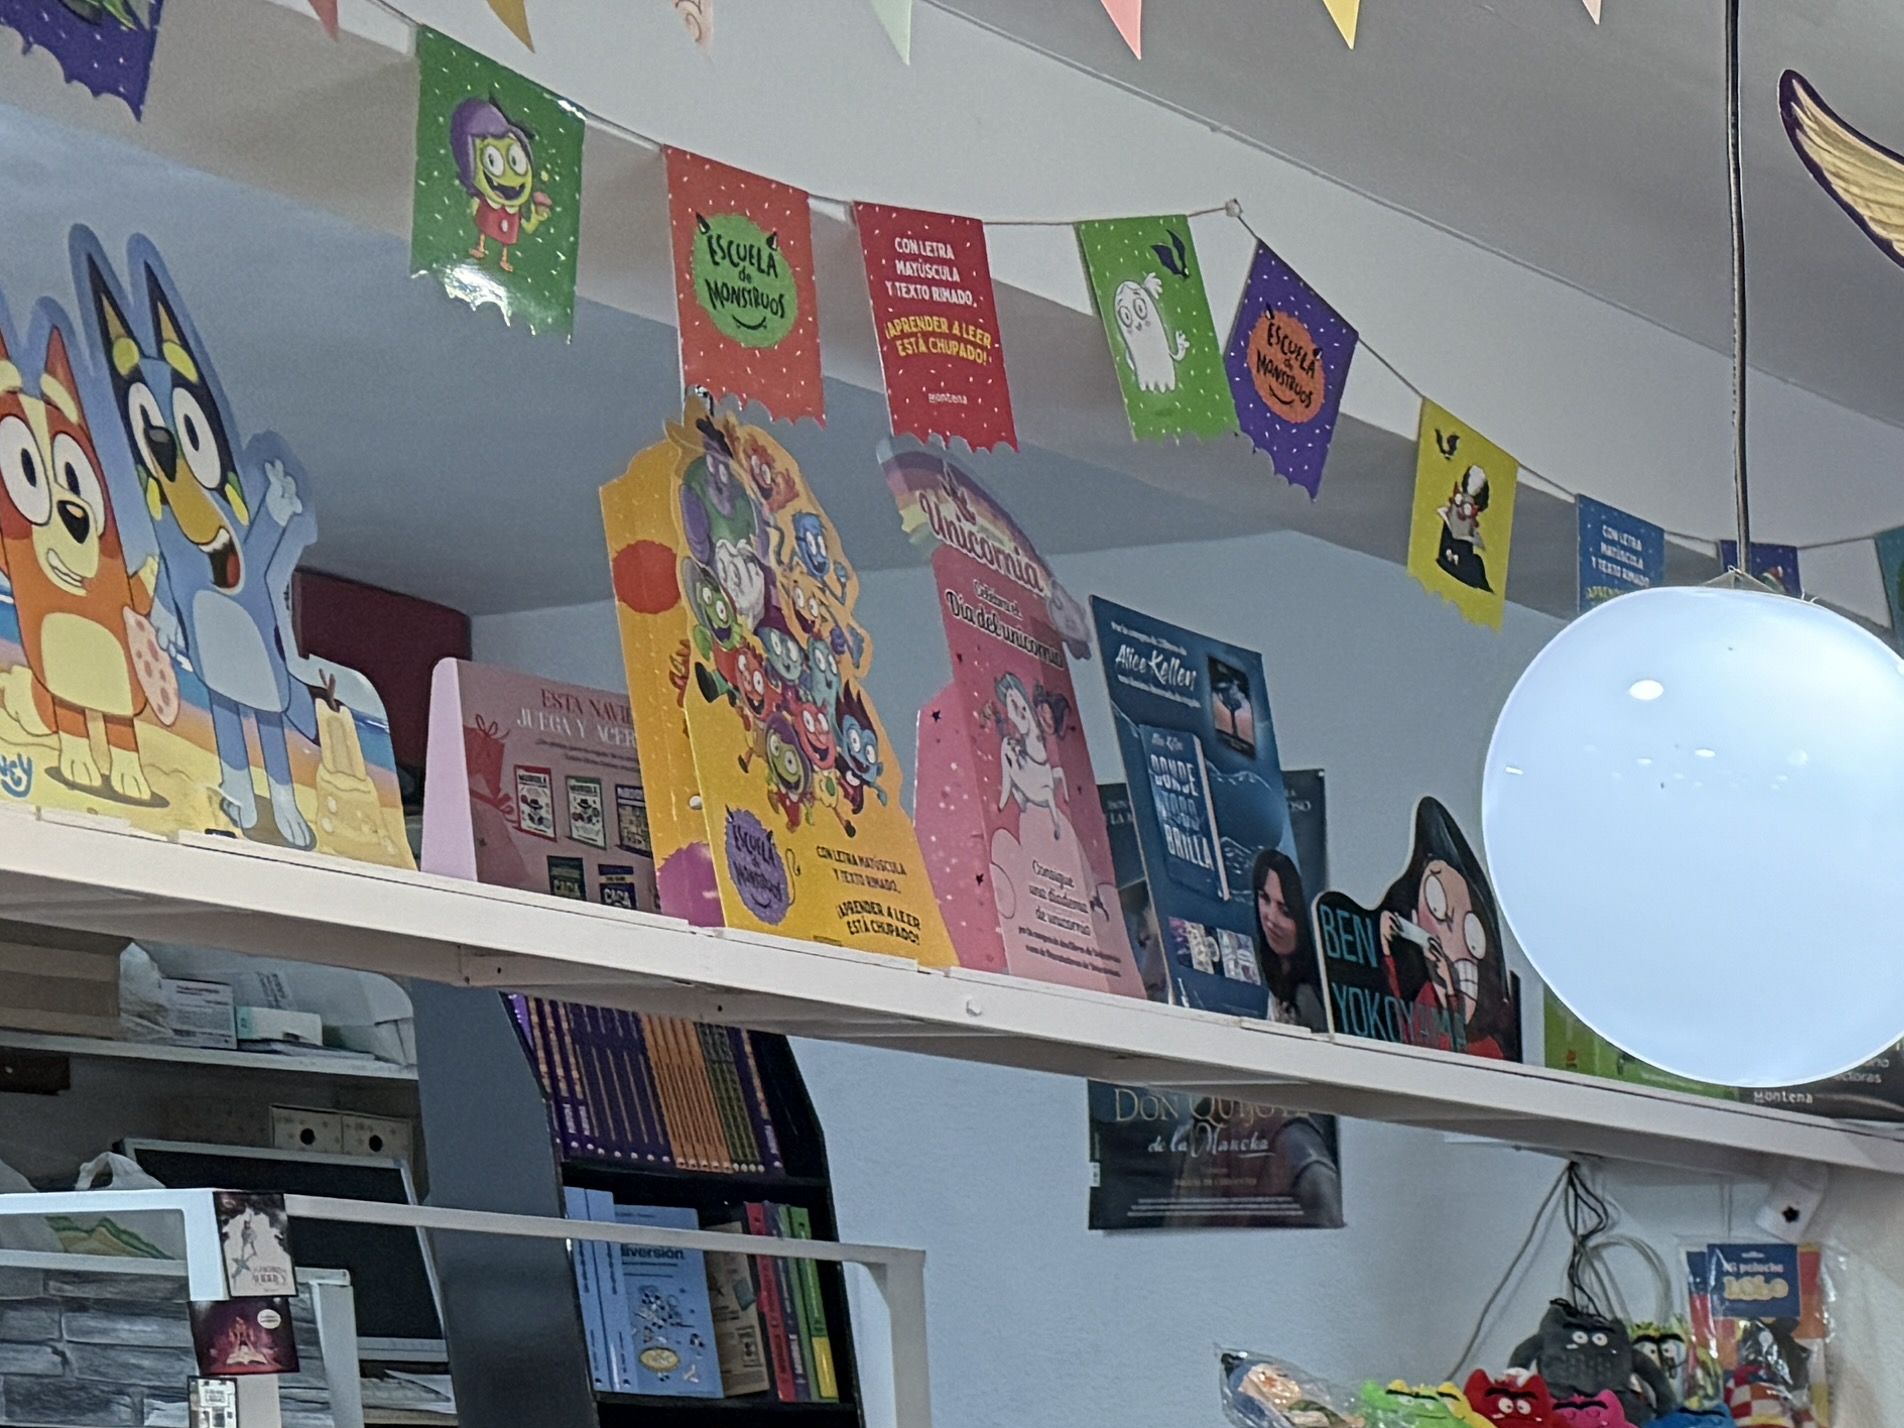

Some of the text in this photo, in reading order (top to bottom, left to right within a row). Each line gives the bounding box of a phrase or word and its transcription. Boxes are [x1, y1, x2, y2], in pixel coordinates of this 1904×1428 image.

[707, 234, 778, 279] ESCUELA
[895, 237, 955, 260] CON LETRA
[738, 266, 752, 284] de
[896, 259, 960, 283] MAYÚSCULA
[705, 278, 785, 319] MONSTRUOS
[885, 281, 930, 301] Y TEXTO
[885, 316, 991, 349] ¡APRENDER A LEER
[896, 333, 987, 365] ESTÁ CHUPADO!
[1267, 322, 1317, 378] ESCUELA
[1256, 350, 1313, 409] MONSTRUOS
[917, 489, 1044, 594] Unicornia
[1116, 644, 1146, 674] Alice
[1149, 649, 1196, 691] Kellen
[541, 688, 584, 715] ESTA
[517, 707, 586, 738] JUEGA Y
[733, 823, 775, 866] ESCUELA
[816, 846, 833, 860] CON
[834, 850, 858, 866] LETRA
[1163, 823, 1214, 872] BRILLA
[833, 868, 839, 881] Y
[847, 915, 870, 935] ESTÁ
[887, 903, 893, 917] A
[894, 906, 920, 931] LEER
[1321, 904, 1379, 968] BEN
[1331, 980, 1467, 1054] YOKOYAMA
[1115, 1088, 1179, 1122] DON
[1190, 1122, 1271, 1158] Mancha
